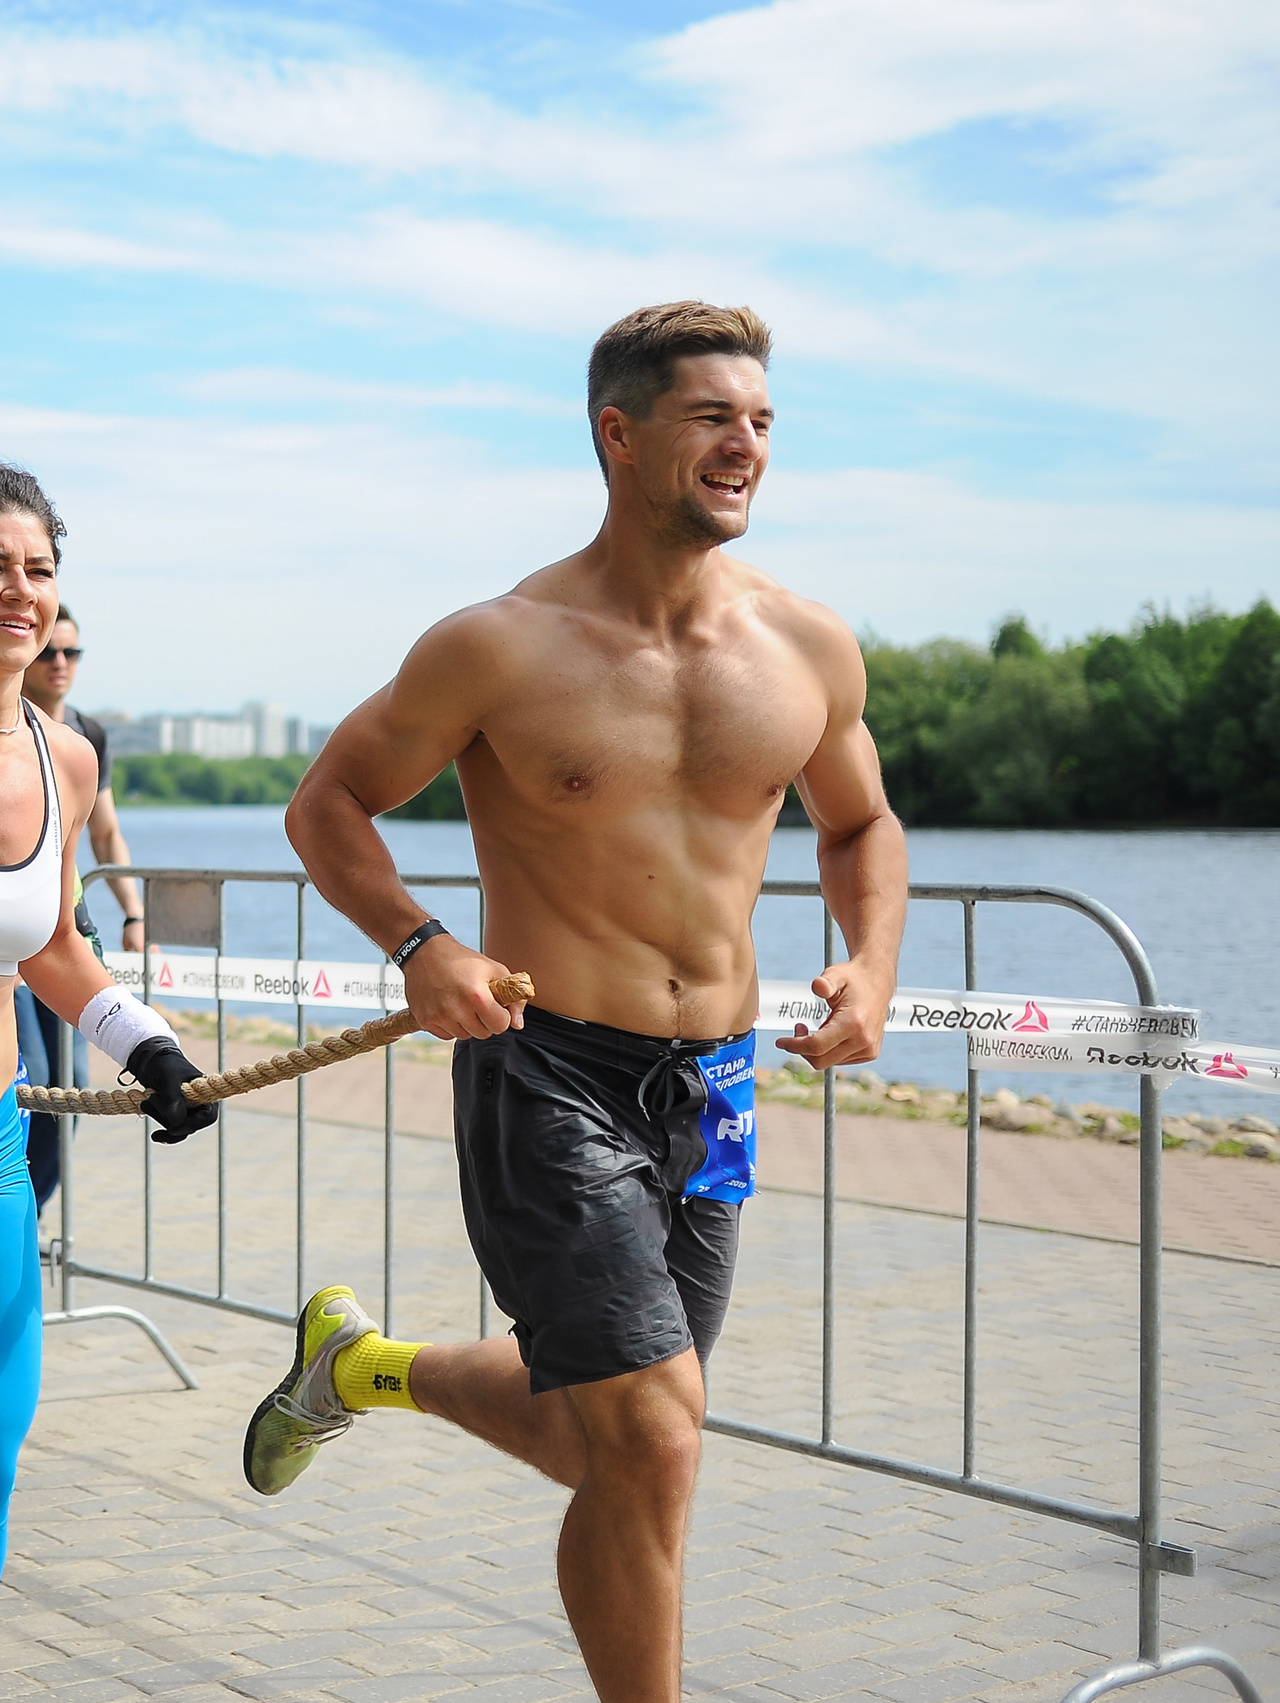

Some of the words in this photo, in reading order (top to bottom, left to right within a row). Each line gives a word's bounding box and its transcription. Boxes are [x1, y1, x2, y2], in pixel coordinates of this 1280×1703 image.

[254, 974, 309, 996] Reebok
[909, 1004, 1013, 1031] Reebok
[706, 1057, 746, 1080] СТАНЬ
